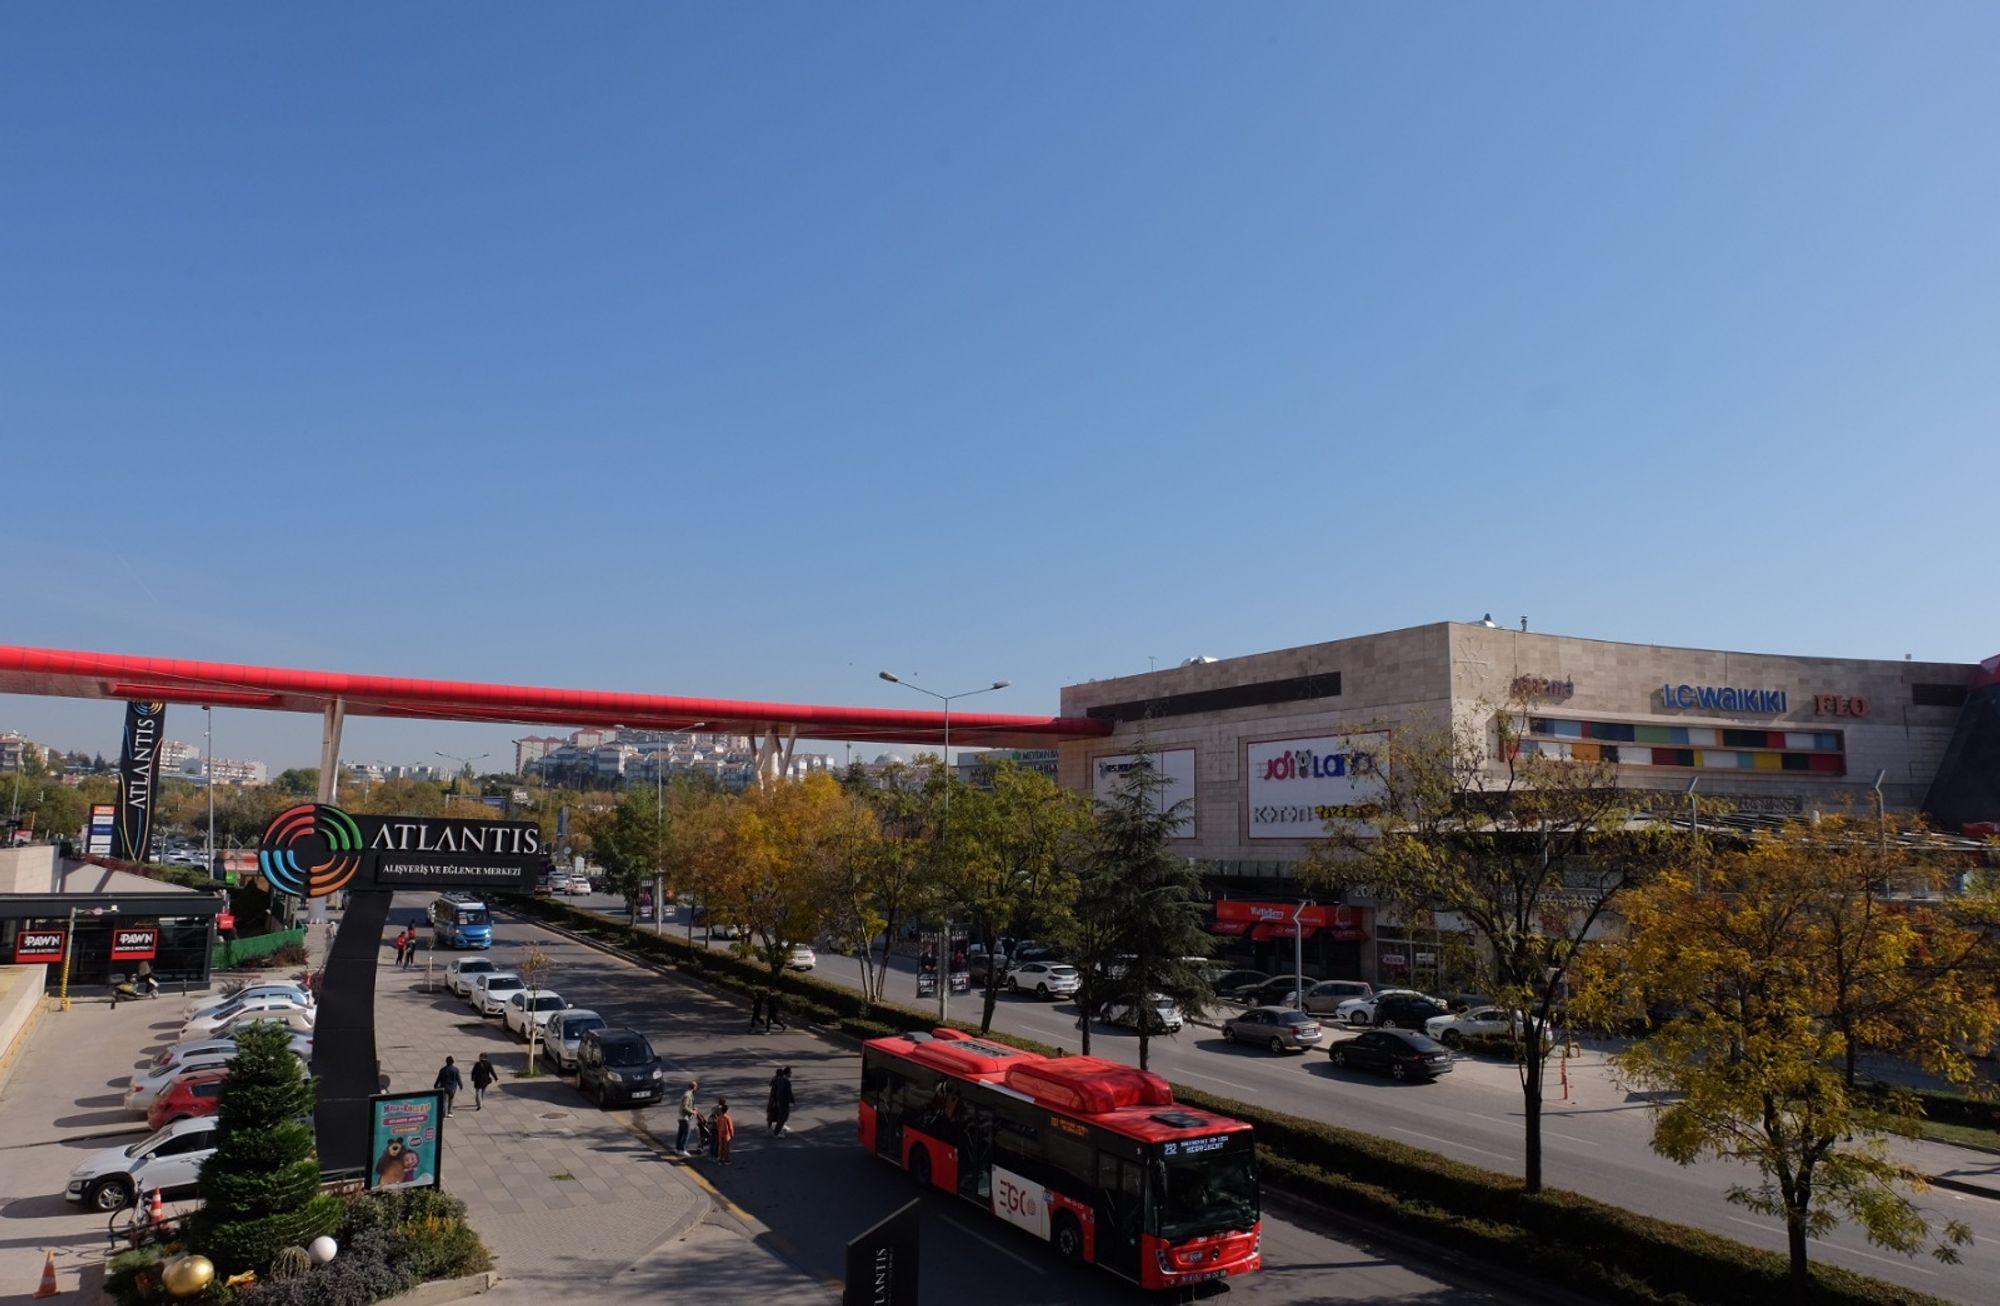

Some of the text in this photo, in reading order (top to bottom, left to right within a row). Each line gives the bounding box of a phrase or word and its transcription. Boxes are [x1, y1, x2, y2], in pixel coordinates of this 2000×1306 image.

[1662, 684, 1693, 709] LC
[128, 718, 155, 809] ATLANTIS
[370, 823, 539, 854] ATLANTIS
[383, 863, 522, 876] ALIŞVERİŞ VE EĞLENCE MERKEZİ
[24, 934, 60, 947] PAWN
[119, 932, 153, 945] PAWN
